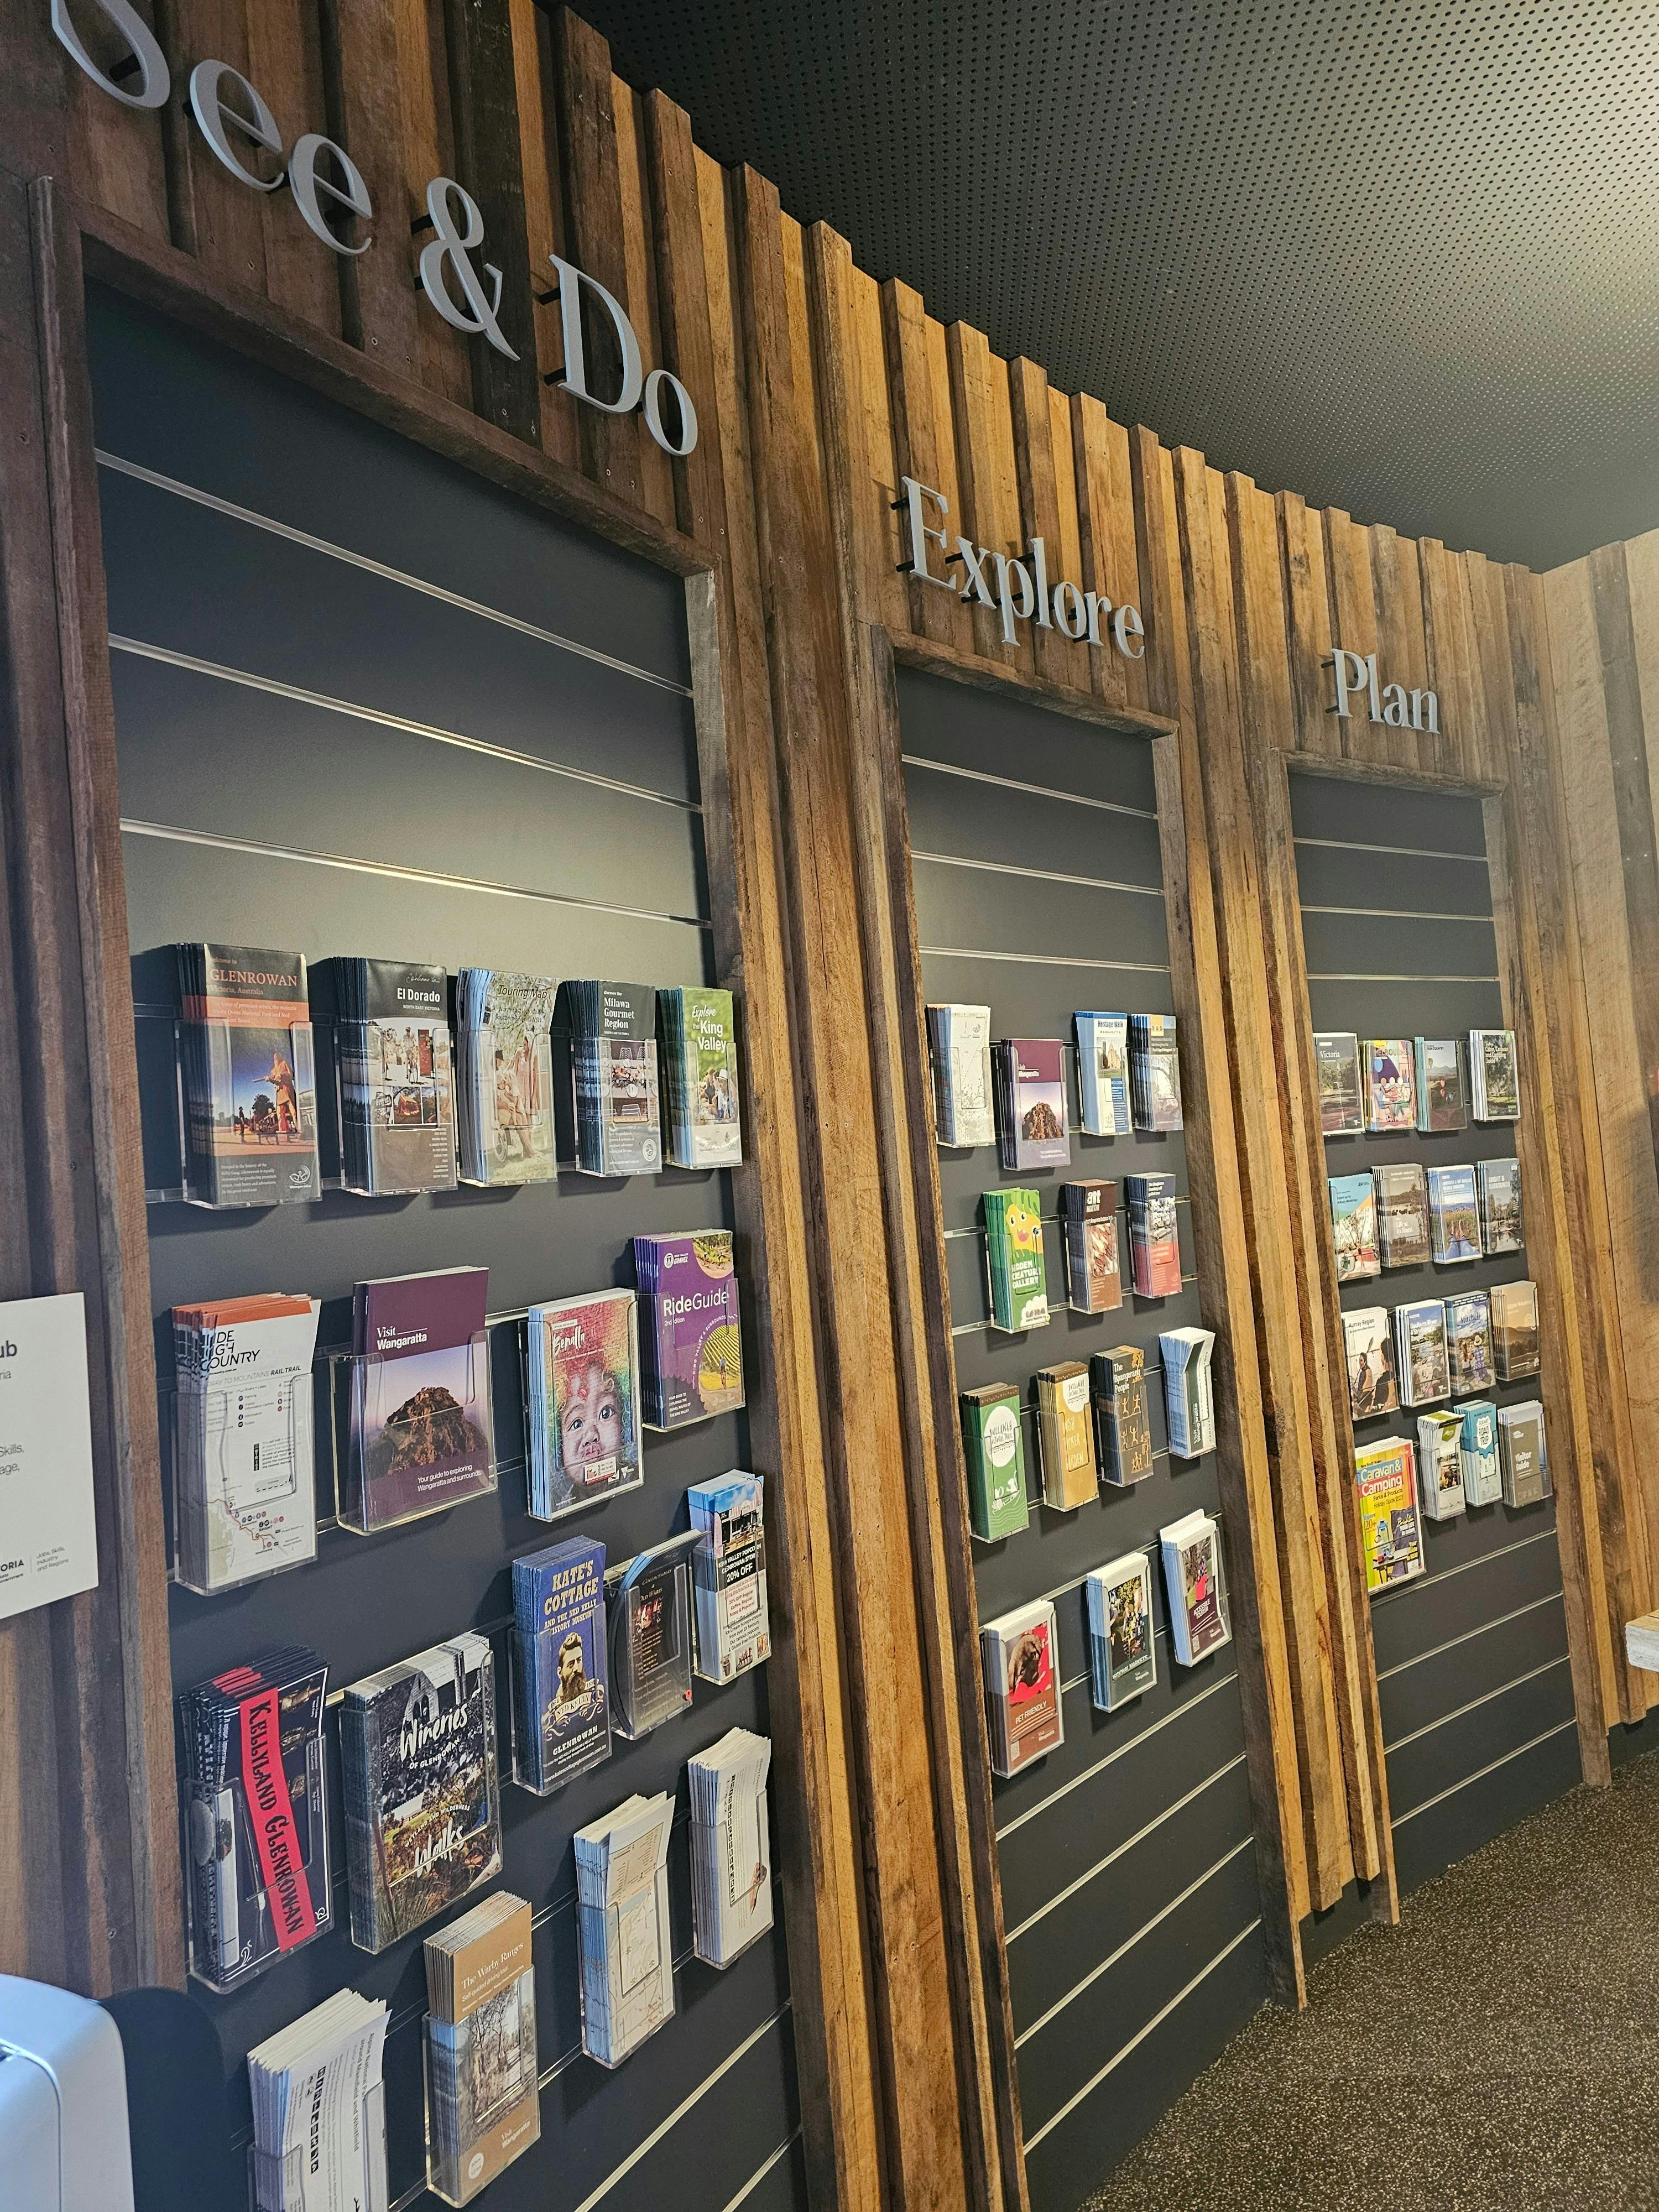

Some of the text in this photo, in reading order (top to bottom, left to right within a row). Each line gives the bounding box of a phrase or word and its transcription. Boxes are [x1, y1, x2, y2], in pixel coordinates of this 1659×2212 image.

[420, 177, 520, 361] &
[549, 254, 698, 456] Do
[901, 476, 1145, 658] Explore
[1331, 648, 1440, 734] Plan
[210, 969, 298, 987] GLENROWAN
[397, 988, 440, 1003] El Dorado
[498, 984, 547, 1000] Touring Map
[604, 997, 630, 1008] Milawa
[604, 1008, 635, 1019] Gourmet
[692, 1005, 717, 1023] Explore
[604, 1018, 629, 1030] Region
[700, 1020, 723, 1037] King
[1098, 1020, 1113, 1029] Heritage
[697, 1036, 727, 1054] Valley
[1320, 1050, 1340, 1058] Victoria
[663, 1287, 729, 1317] RideGuide
[377, 1326, 396, 1338] Visit
[377, 1332, 427, 1350] Wangaratta
[553, 1325, 585, 1357] Benalla
[1114, 1363, 1123, 1373] The
[1114, 1383, 1130, 1394] People
[1515, 1452, 1532, 1463] Visitor
[1516, 1460, 1530, 1472] Guide
[418, 1475, 430, 1484] Your
[430, 1472, 444, 1482] guide
[450, 1464, 472, 1475] exploring
[1360, 1460, 1402, 1482] Caravan &
[417, 1479, 446, 1492] Wangaratta
[1361, 1474, 1403, 1496] Camping
[1373, 1492, 1384, 1501] Parks
[1387, 1488, 1403, 1497] Products
[727, 1552, 742, 1563] VALLEY
[552, 1560, 593, 1592] KATE'S
[727, 1562, 753, 1583] 20% OFF
[544, 1577, 599, 1615] COTTAGE
[544, 1599, 597, 1630] AND THE NED KELLY
[572, 1609, 593, 1626] MUSEUM
[570, 1694, 589, 1710] KELLY
[1015, 1700, 1047, 1724] PET FRIENDLY
[399, 1703, 468, 1762] Wineries
[553, 1725, 598, 1756] GLENROWAN
[249, 1699, 278, 1811] KELLYLAND
[419, 1737, 461, 1767] GLENROWAN
[429, 1812, 440, 1822] AND
[442, 1804, 470, 1813] WILDERNESS
[415, 1817, 464, 1878] Walks
[265, 1814, 305, 1935] GLENROWAN
[461, 1976, 477, 1989] The
[477, 1960, 499, 1978] Warby
[500, 1943, 524, 1963] Ranges
